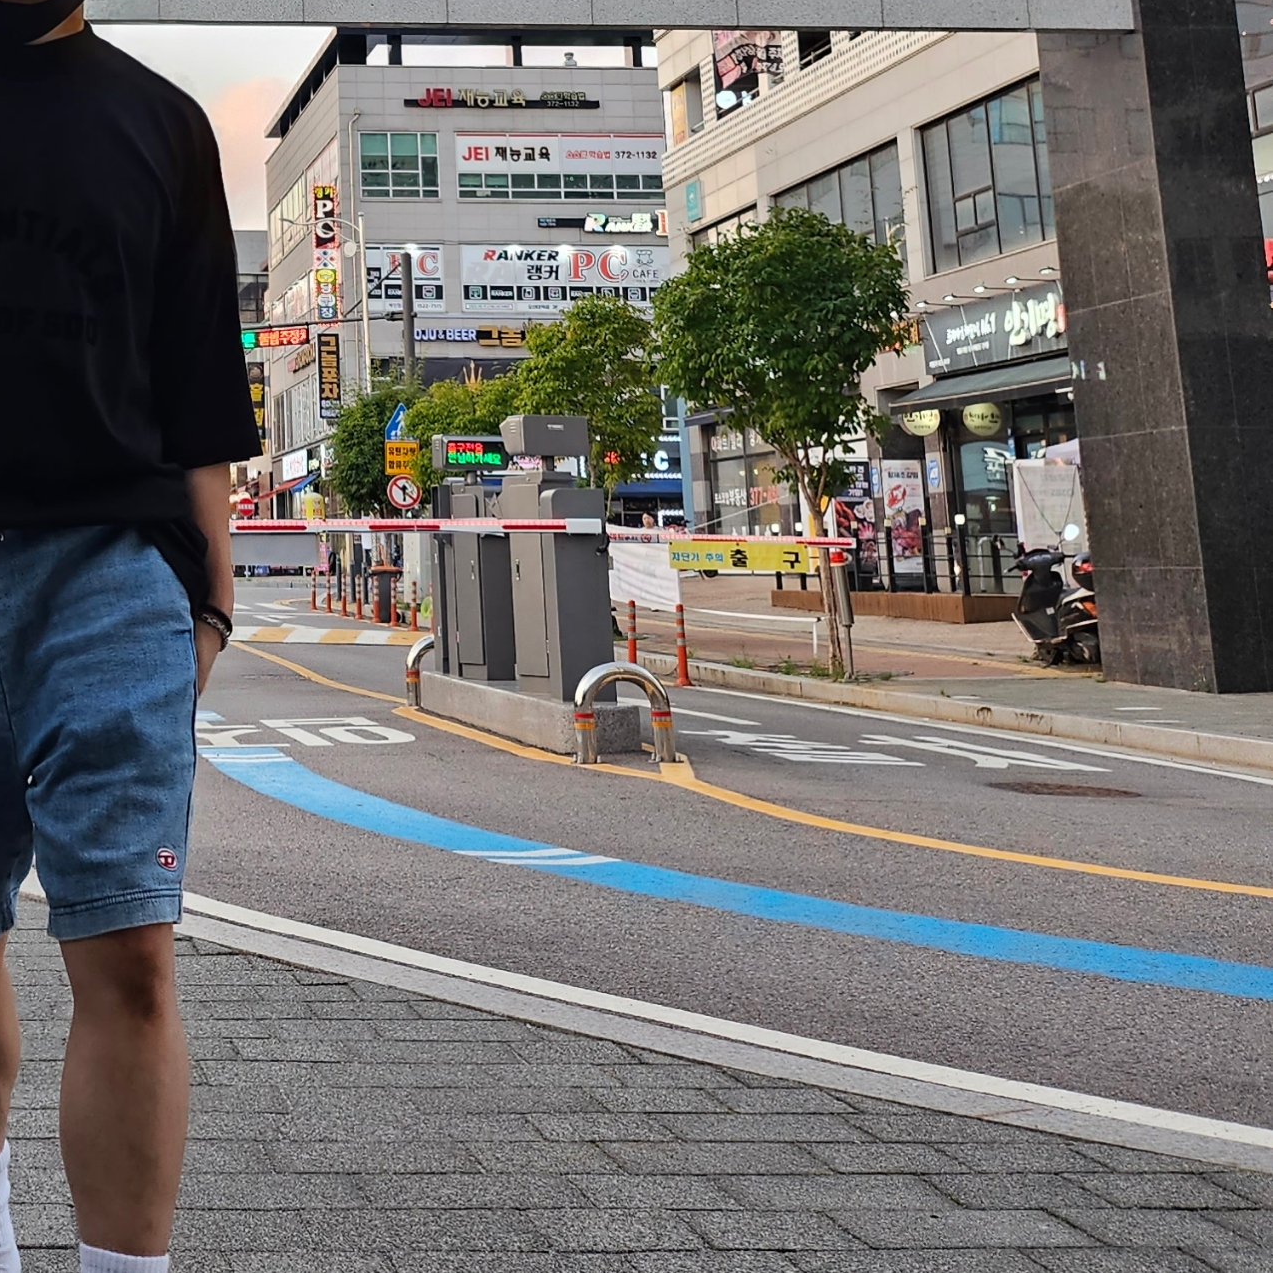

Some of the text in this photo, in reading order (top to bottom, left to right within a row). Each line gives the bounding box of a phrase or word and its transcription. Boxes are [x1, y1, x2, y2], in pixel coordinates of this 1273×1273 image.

[417, 88, 453, 107] JEI
[458, 88, 526, 107] 재능교육
[462, 146, 489, 161] JEI
[494, 146, 551, 162] 재능교육
[614, 151, 658, 160] 372-1132
[483, 250, 629, 282] RANKER PC
[527, 264, 560, 280] 랭커
[632, 270, 659, 278] CAFE
